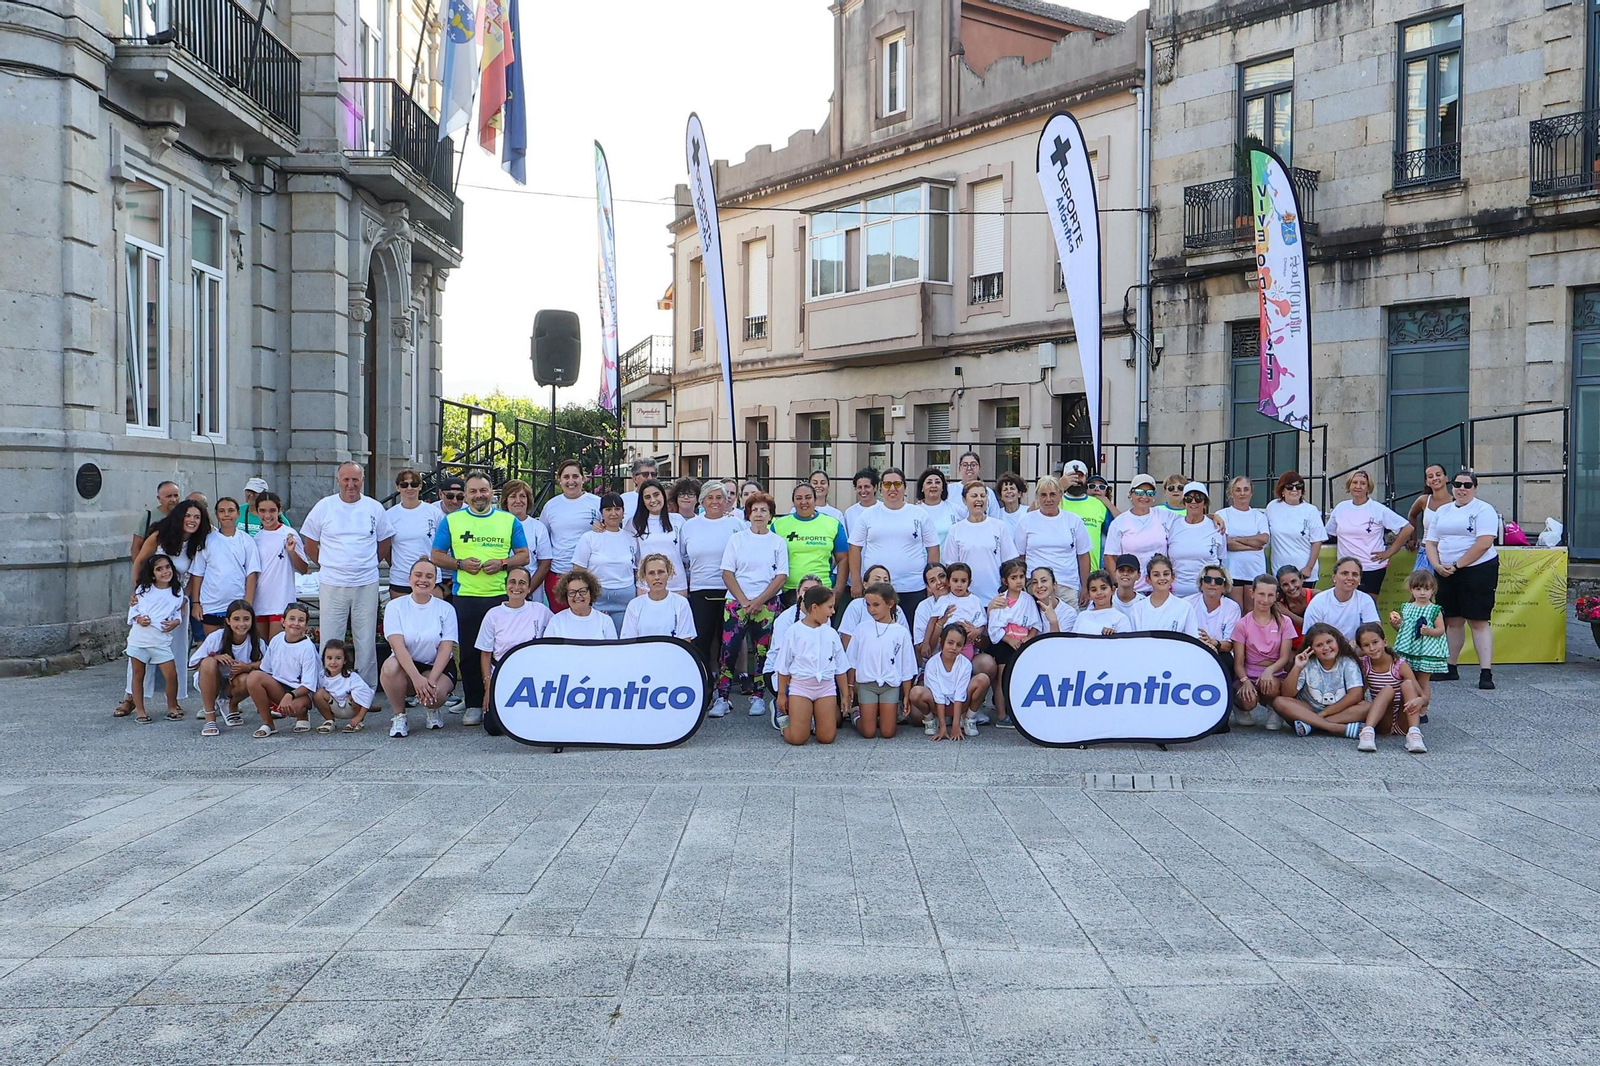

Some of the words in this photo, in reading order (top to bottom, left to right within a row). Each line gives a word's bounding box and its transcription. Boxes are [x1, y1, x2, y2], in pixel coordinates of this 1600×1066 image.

[1057, 168, 1083, 249] DEPORTE
[504, 674, 696, 710] Atlántico
[1021, 670, 1221, 708] Atlántico
